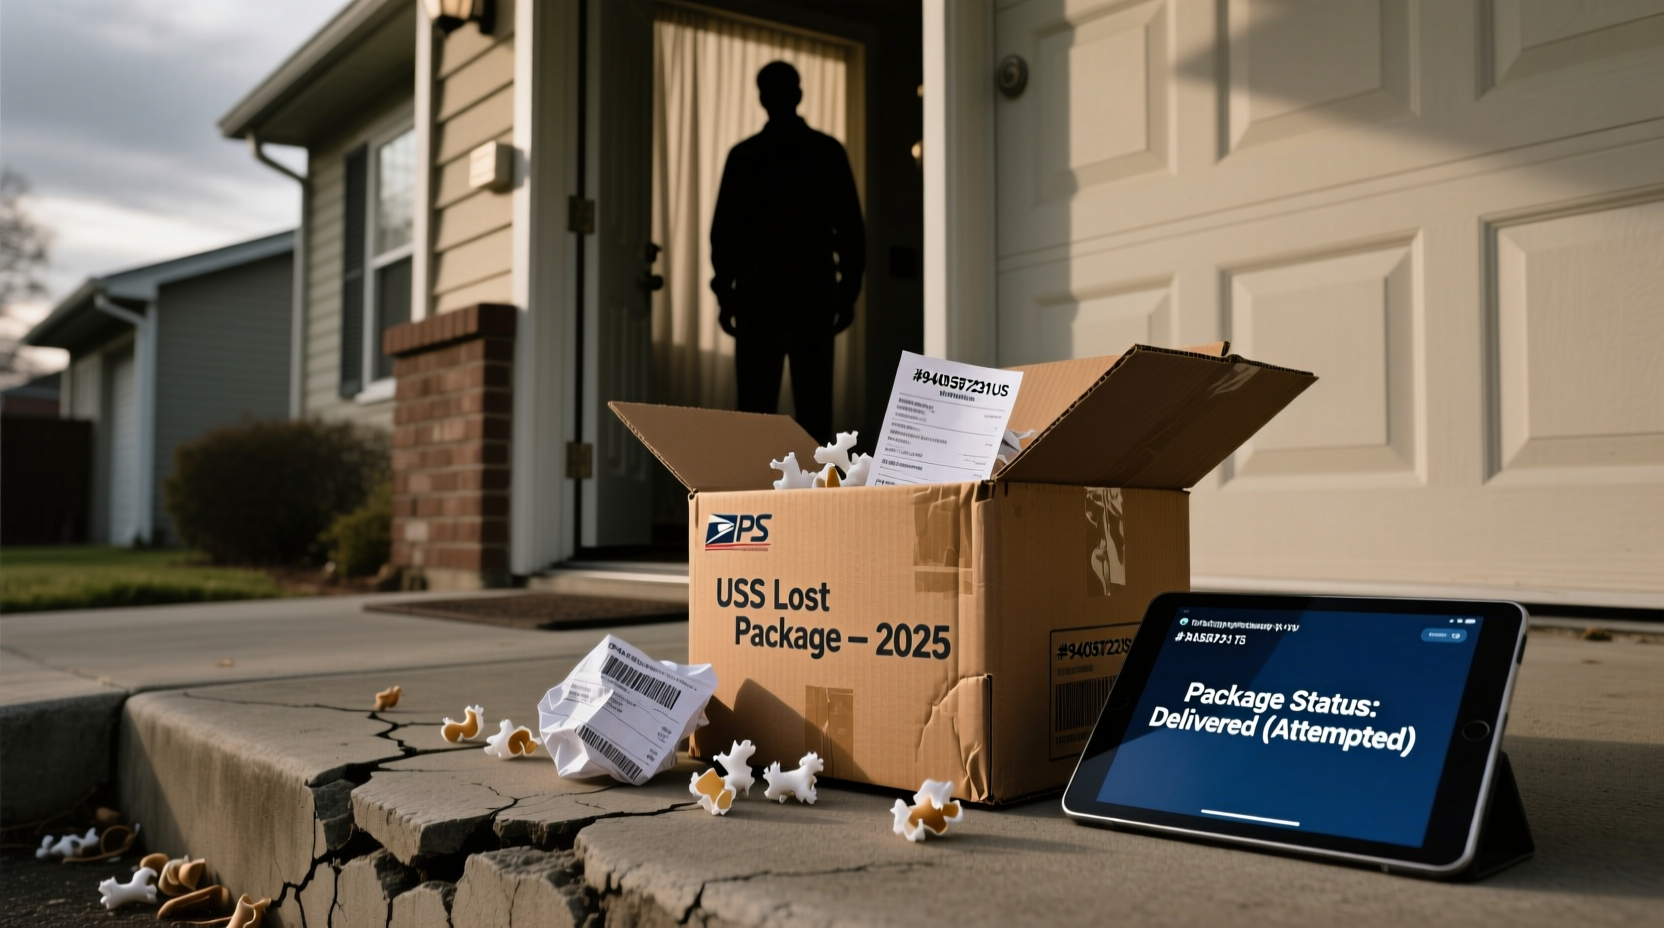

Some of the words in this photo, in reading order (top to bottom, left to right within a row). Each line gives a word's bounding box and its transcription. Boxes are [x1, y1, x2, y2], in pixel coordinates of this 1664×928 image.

[716, 577, 766, 609] USS
[774, 578, 830, 612] Lost
[735, 615, 842, 660] Package
[875, 622, 951, 660] 2025
[1184, 682, 1285, 713] Package
[1289, 690, 1381, 718] Status:
[1149, 706, 1259, 737] Delivered
[1262, 714, 1416, 758] (Attempted)
